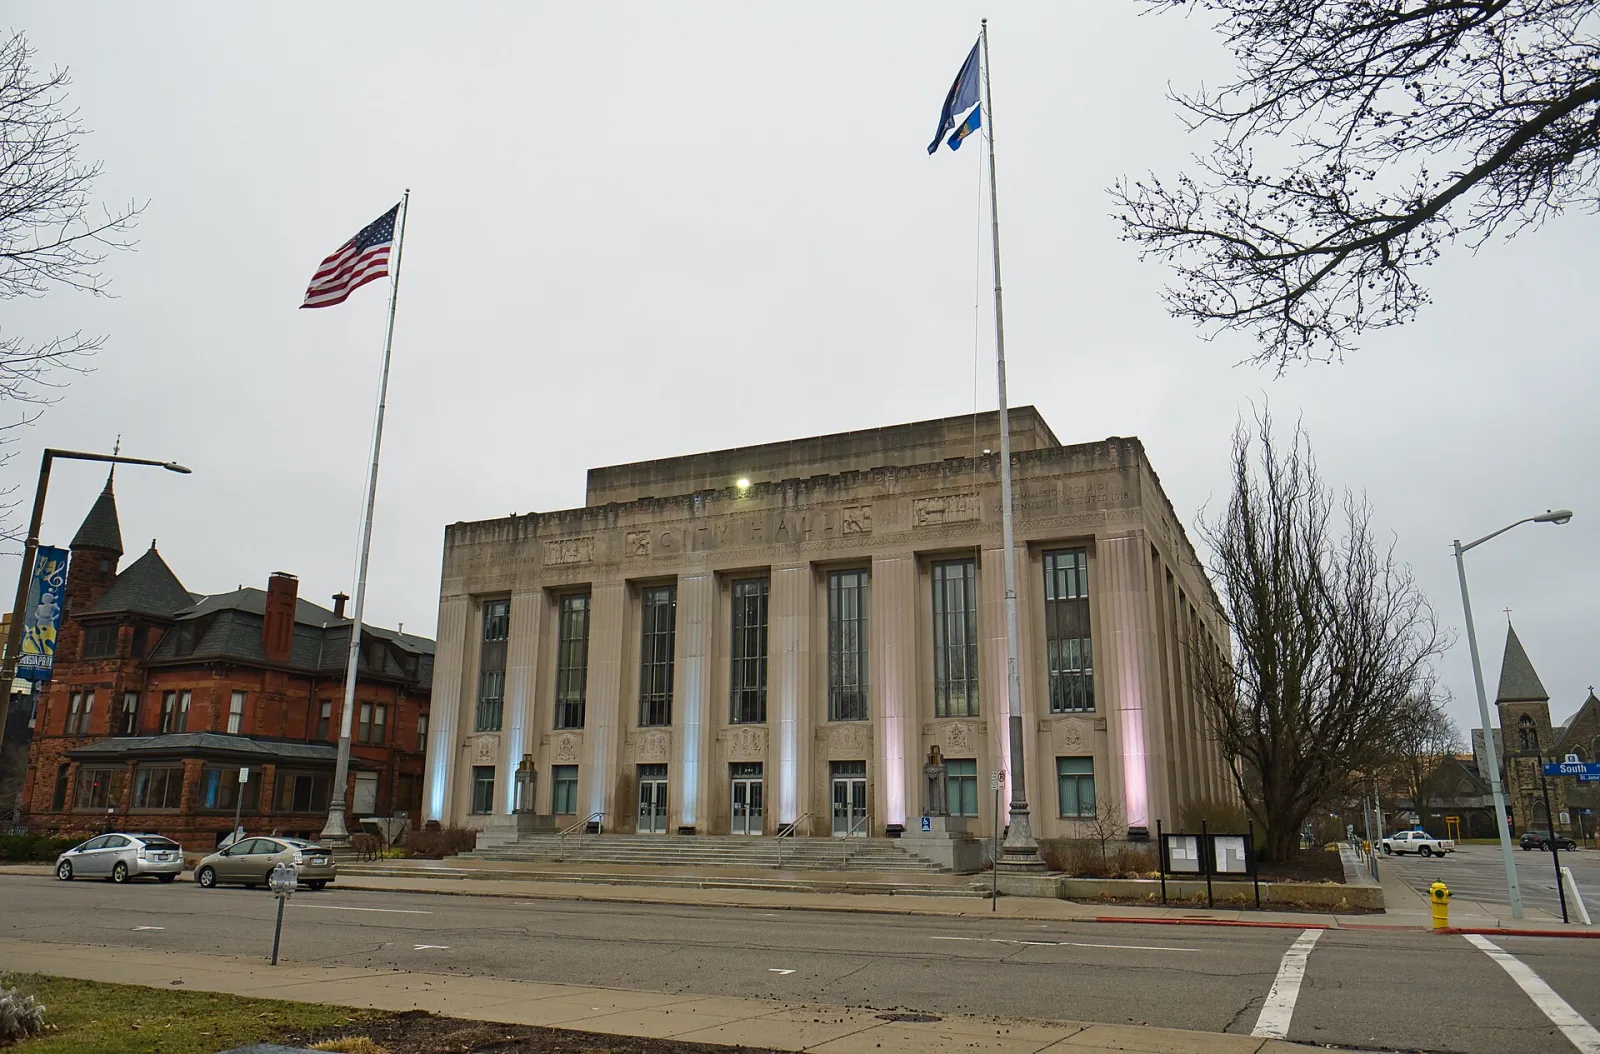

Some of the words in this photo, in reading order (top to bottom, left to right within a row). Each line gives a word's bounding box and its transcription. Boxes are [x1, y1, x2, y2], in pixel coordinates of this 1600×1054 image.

[992, 499, 1052, 513] GOERNMENT
[1056, 495, 1108, 508] INSTITUTED
[1111, 491, 1129, 501] 1918
[659, 525, 729, 548] CITY
[751, 514, 835, 541] HALL
[1559, 764, 1587, 773] South
